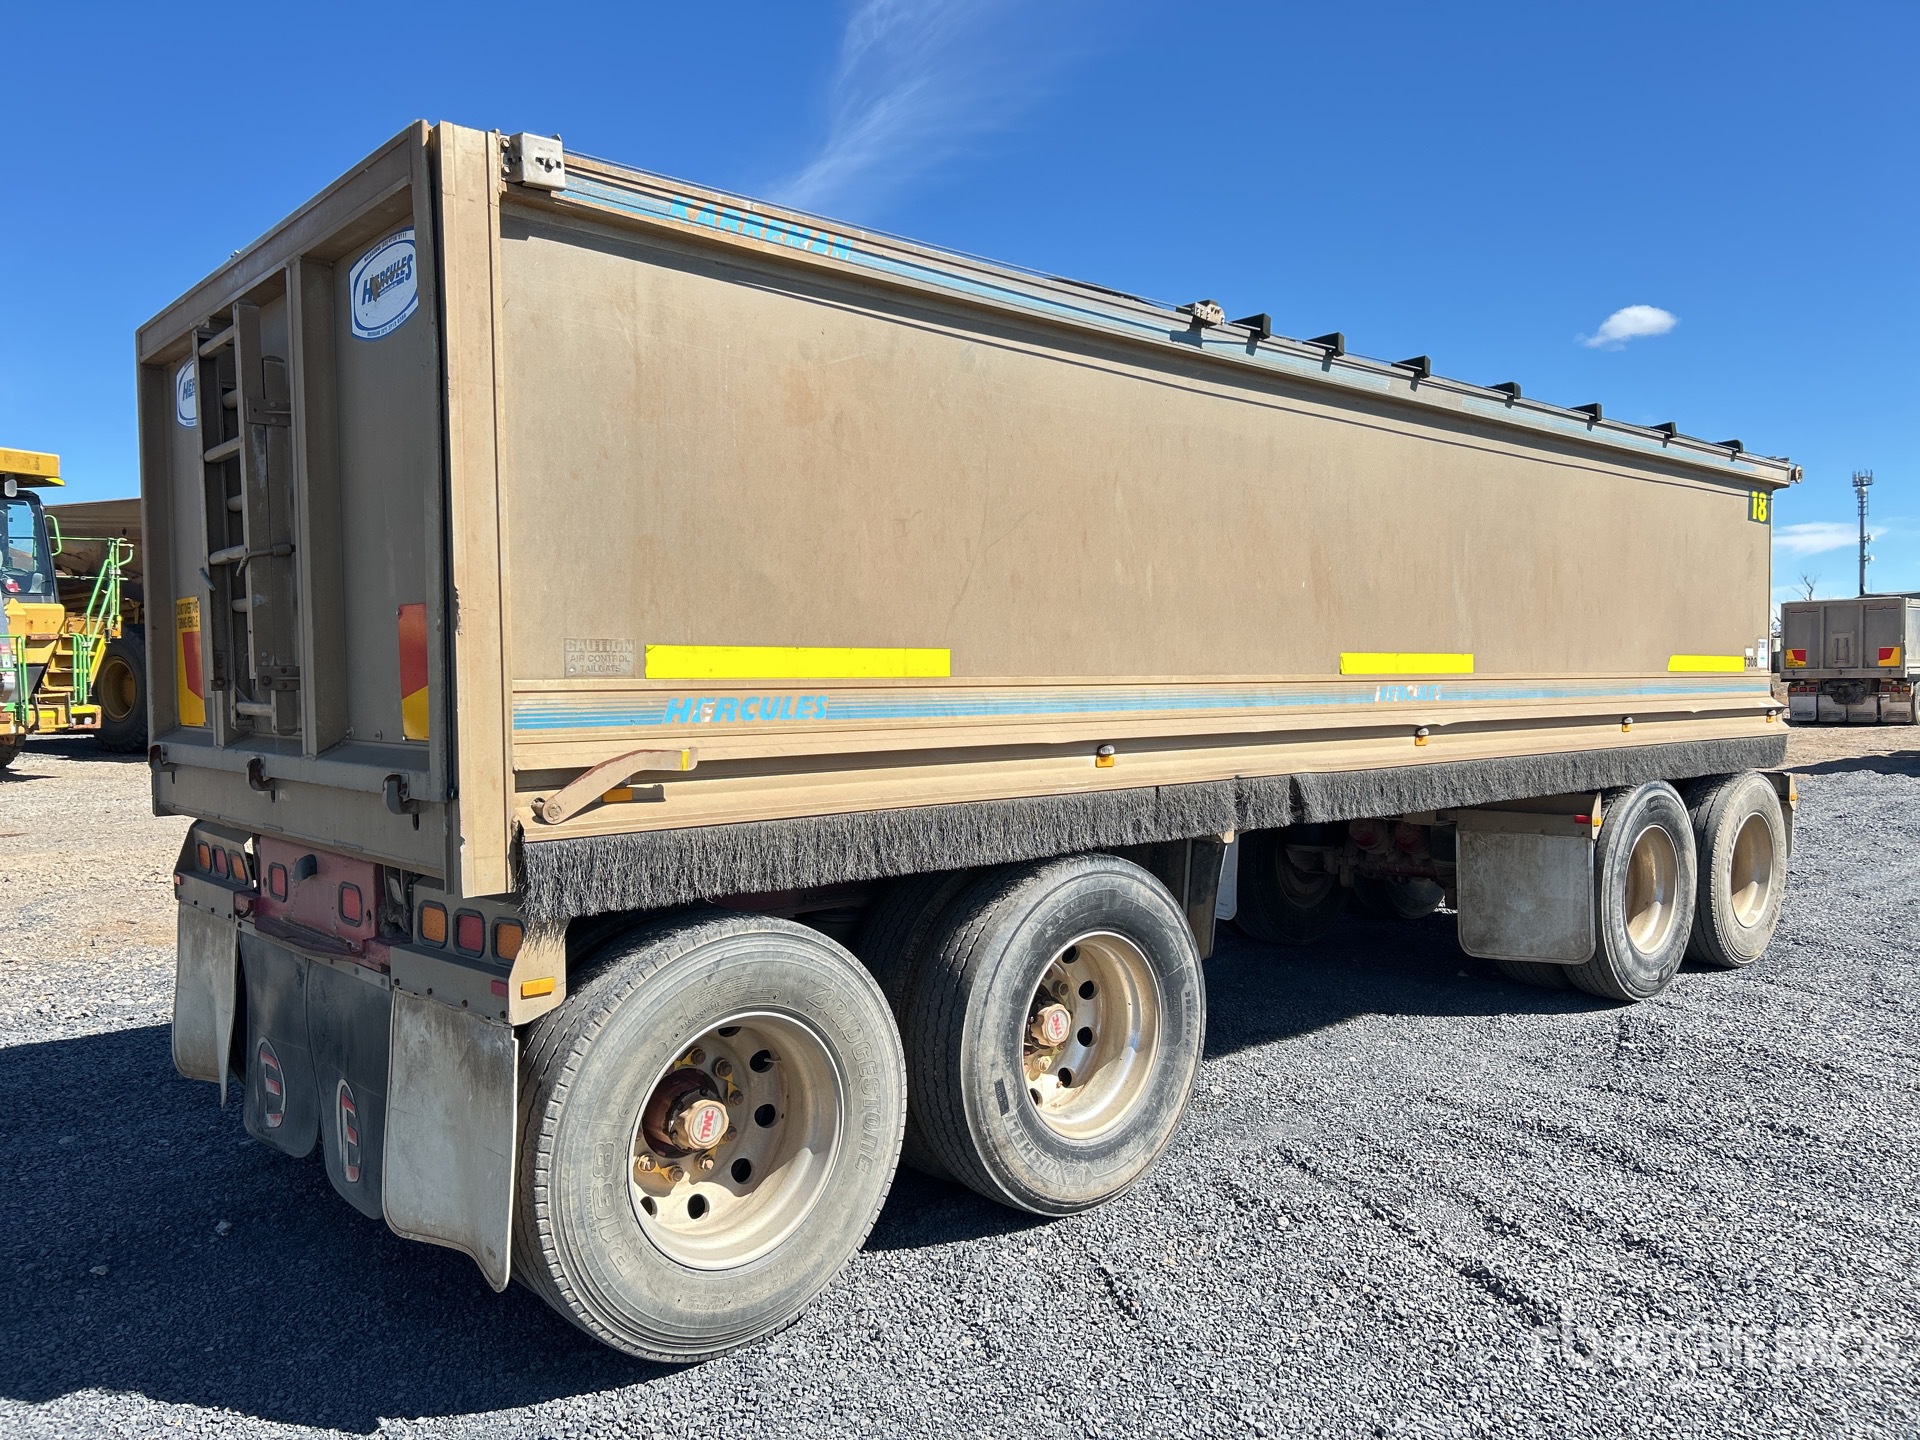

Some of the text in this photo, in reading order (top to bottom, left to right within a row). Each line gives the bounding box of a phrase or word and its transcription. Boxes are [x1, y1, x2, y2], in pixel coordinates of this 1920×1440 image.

[565, 639, 632, 653] CAUTION
[570, 654, 631, 663] AIR CONTROL
[662, 695, 829, 725] HERCULES
[805, 979, 880, 1175] BRIDGESTONE
[700, 1110, 715, 1140] TMC
